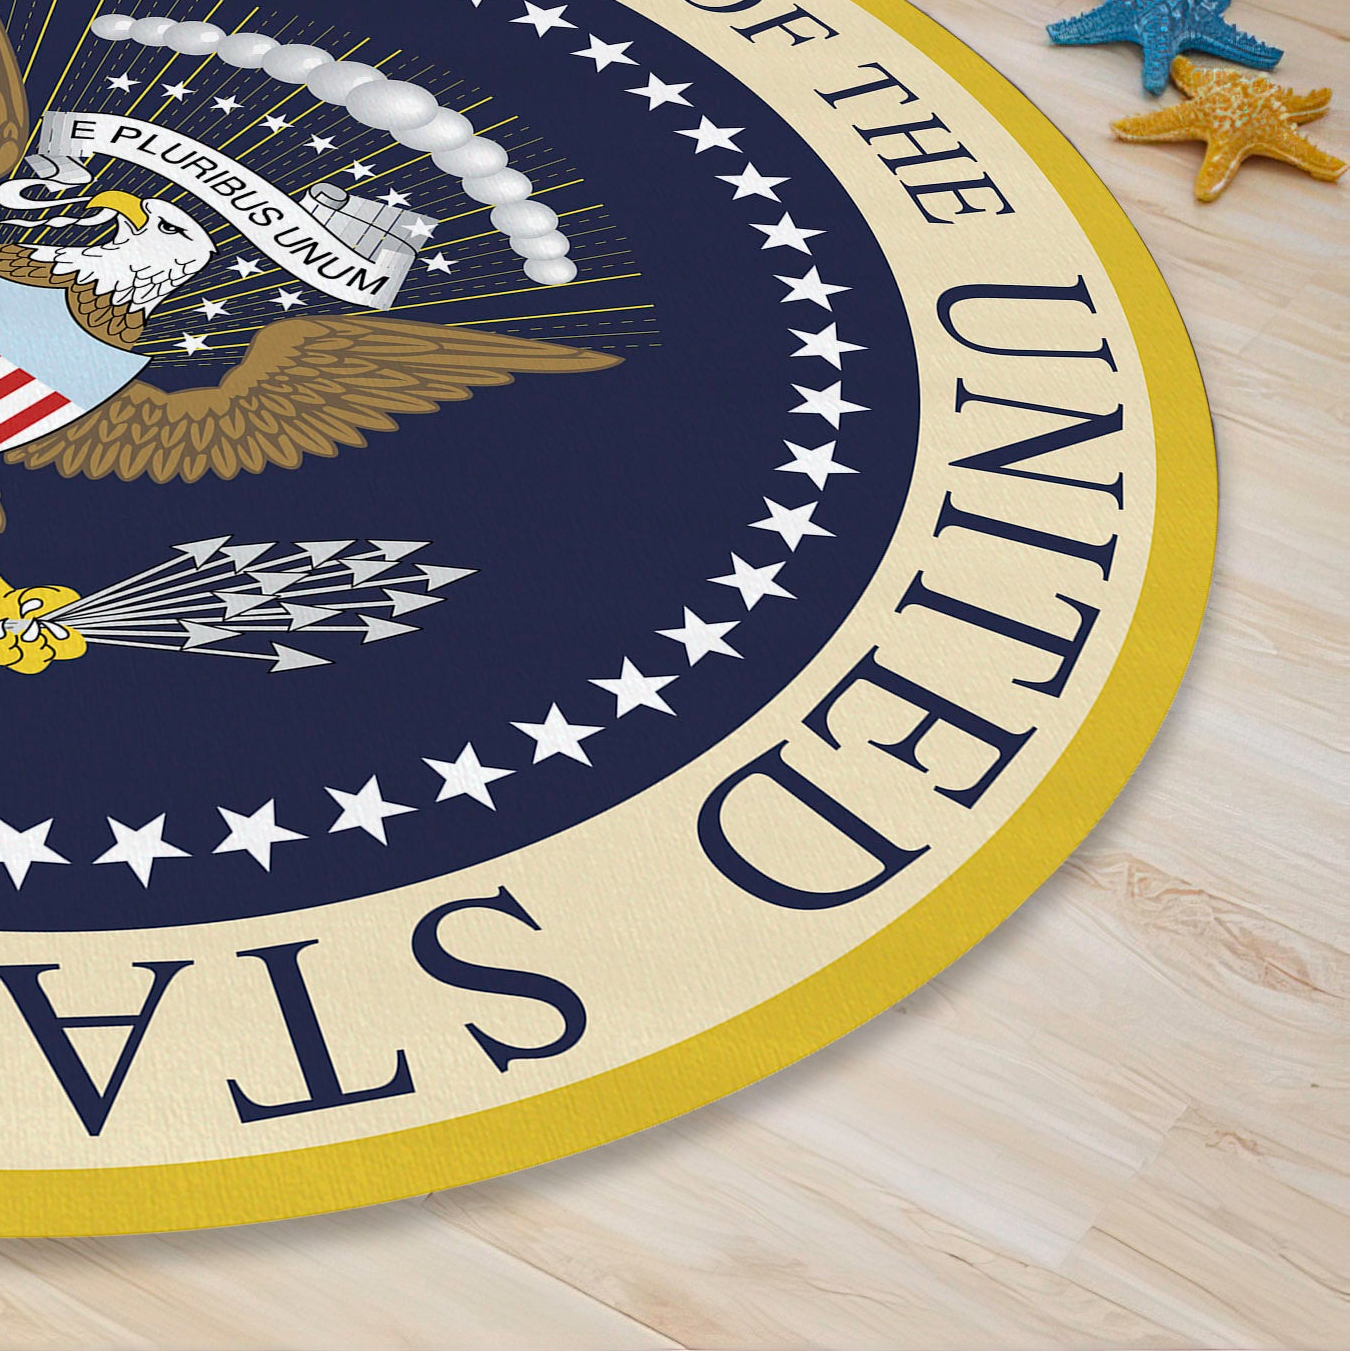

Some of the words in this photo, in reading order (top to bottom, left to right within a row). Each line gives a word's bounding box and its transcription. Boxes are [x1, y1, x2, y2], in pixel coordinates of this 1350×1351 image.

[70, 120, 97, 140] E
[110, 125, 284, 228] PLURIBUS
[273, 226, 390, 296] UNUM
[813, 62, 1017, 225] THE
[696, 274, 1125, 911] UNITED
